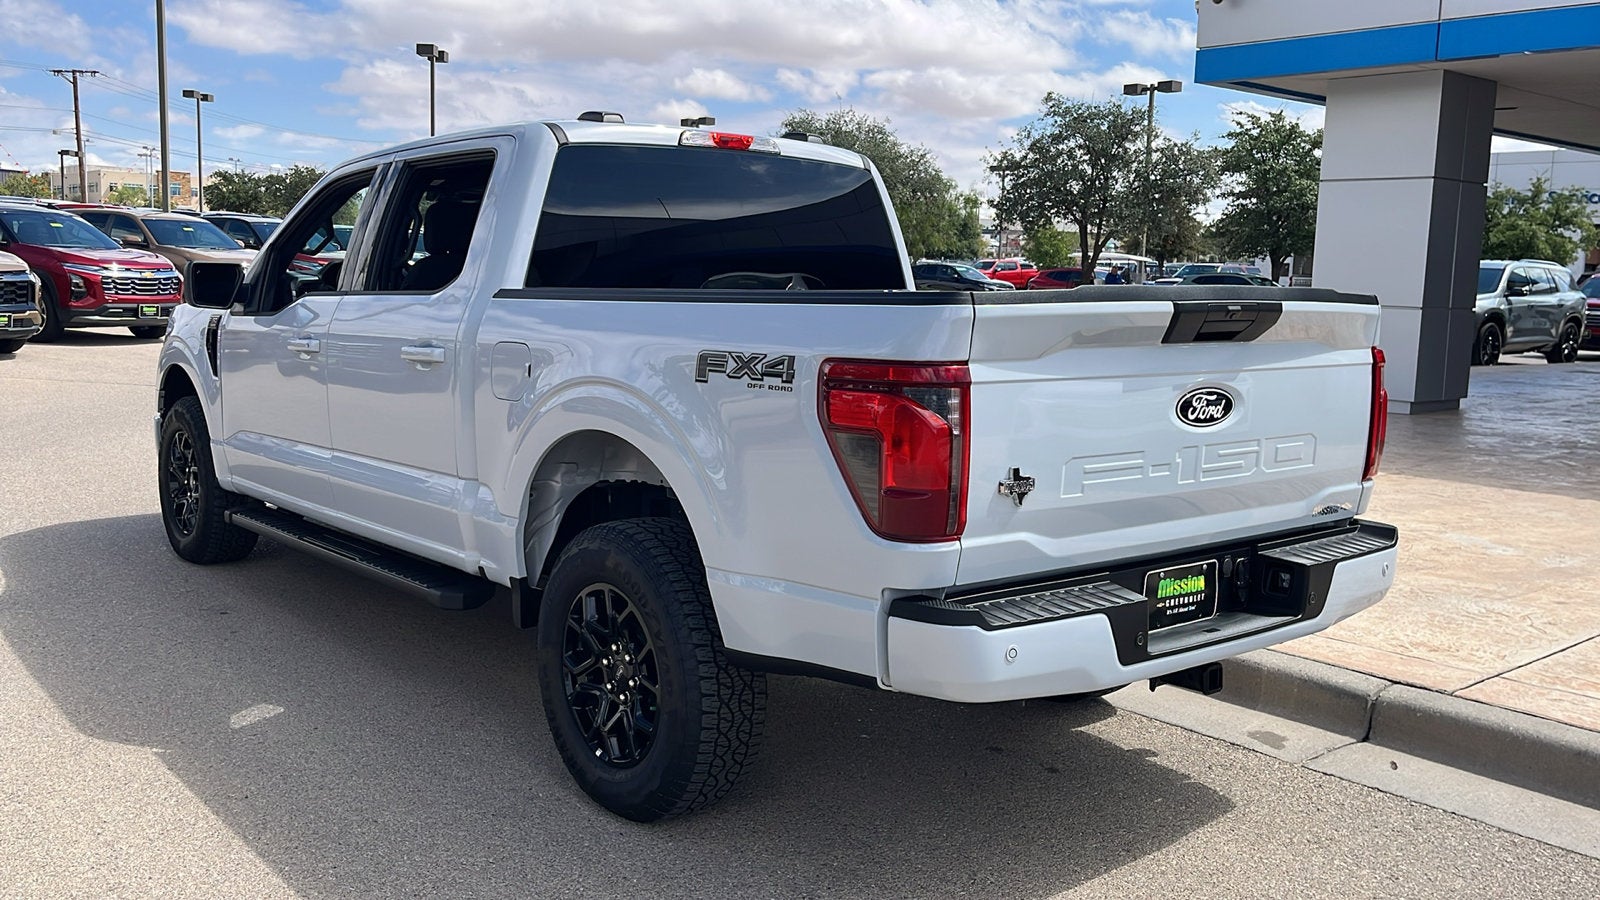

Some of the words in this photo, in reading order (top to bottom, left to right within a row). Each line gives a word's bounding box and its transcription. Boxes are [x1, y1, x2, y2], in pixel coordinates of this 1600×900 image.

[695, 349, 796, 384] FX4
[768, 384, 793, 392] ROAD
[1187, 394, 1227, 421] Ford
[1061, 433, 1317, 498] F-150
[1157, 575, 1205, 599] Mission
[1165, 593, 1205, 607] CHEVROLET
